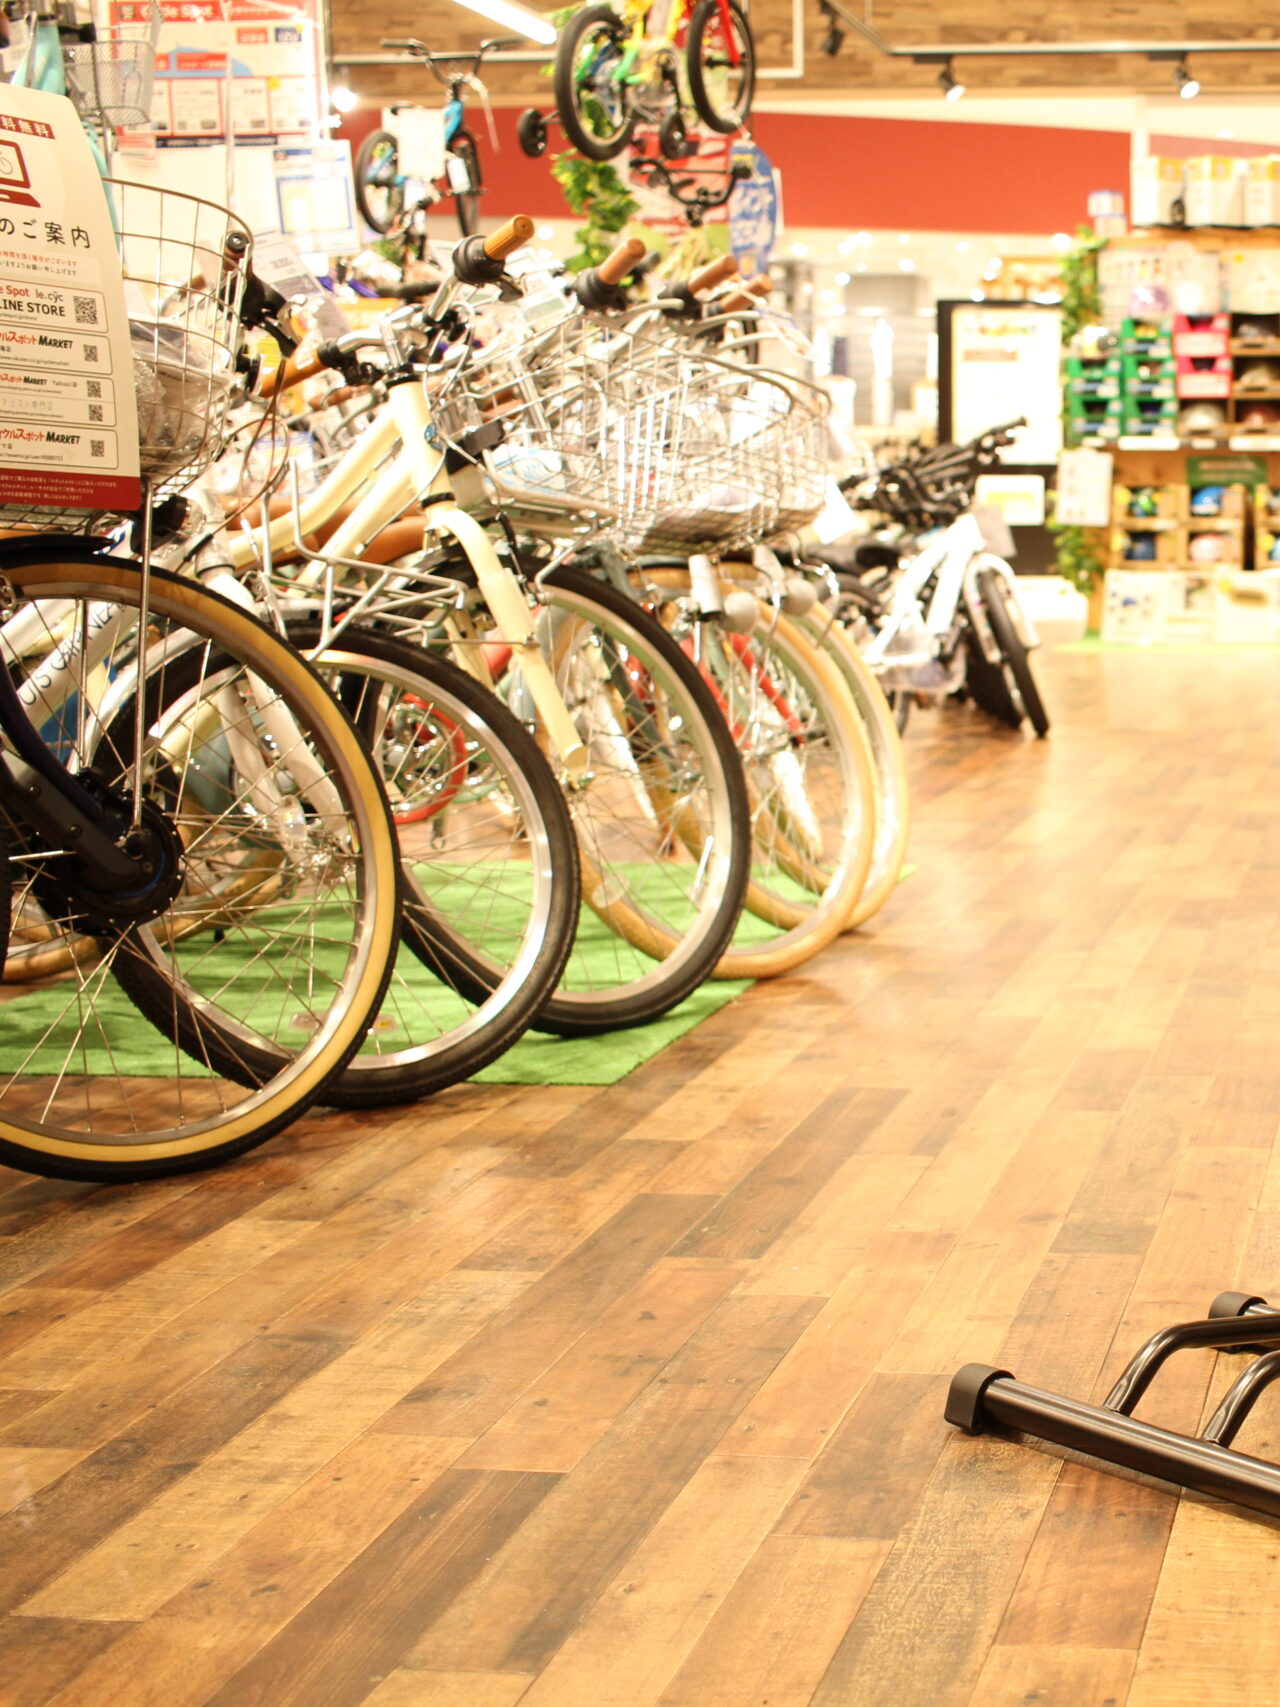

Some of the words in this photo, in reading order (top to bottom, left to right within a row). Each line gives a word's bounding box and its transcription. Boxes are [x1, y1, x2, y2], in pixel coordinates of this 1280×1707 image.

[0, 218, 90, 249] のご案内
[6, 285, 30, 298] Spot
[27, 302, 66, 317] STORE
[38, 335, 73, 349] MARKET
[23, 376, 48, 386] MARKET
[46, 431, 80, 445] MARKET
